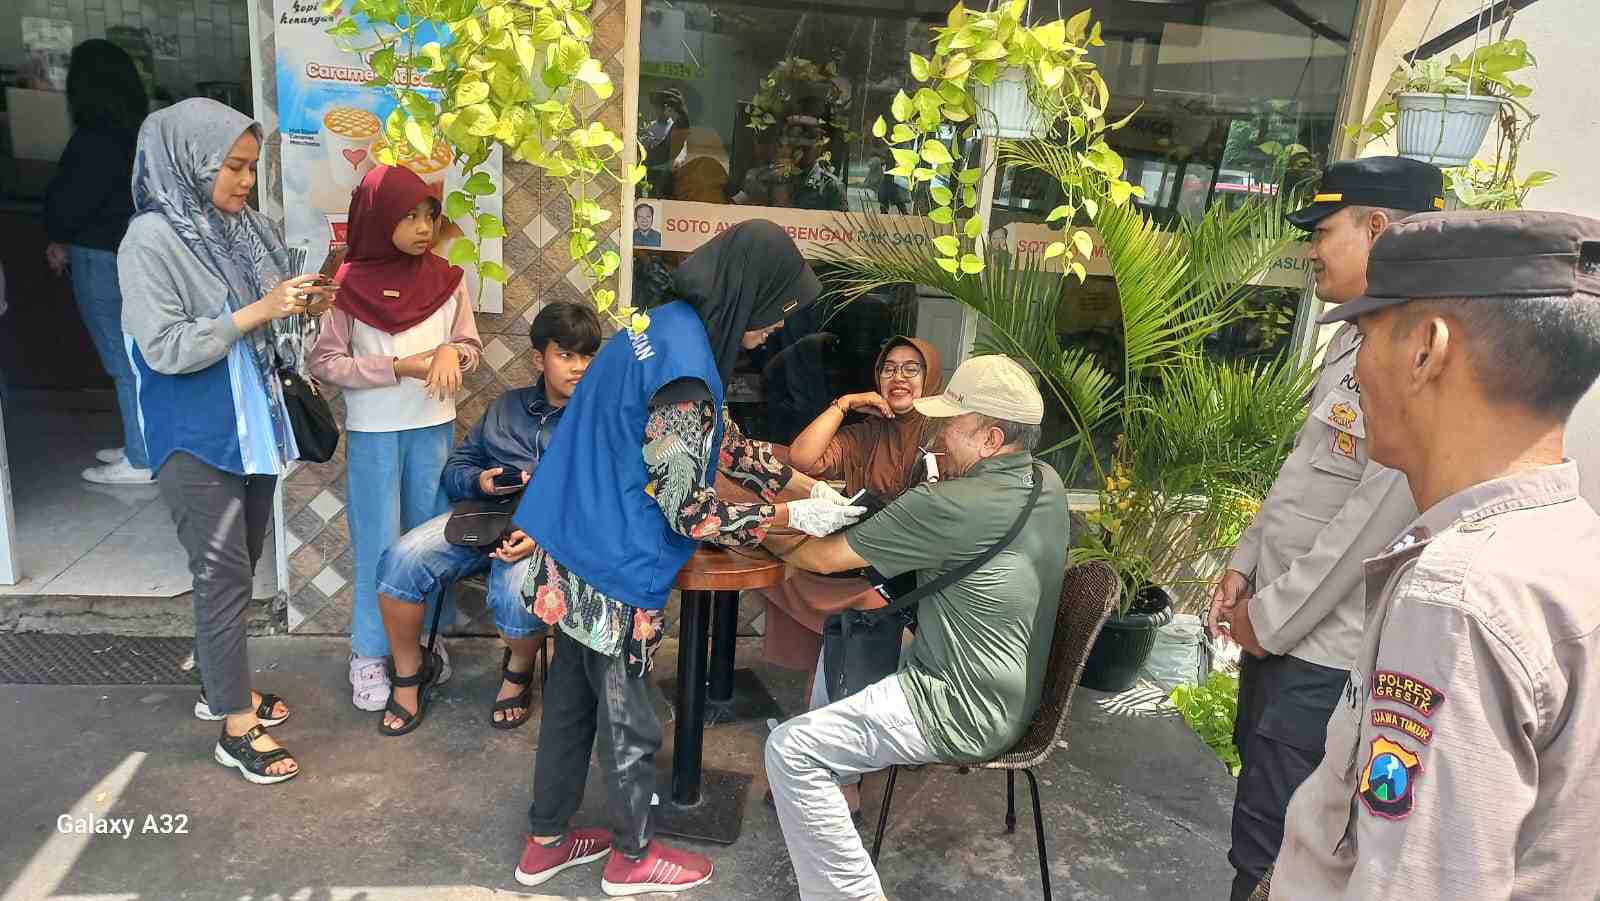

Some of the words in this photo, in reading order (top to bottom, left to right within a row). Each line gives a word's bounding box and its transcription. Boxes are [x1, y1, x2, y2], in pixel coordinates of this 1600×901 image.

[306, 63, 378, 82] Carame
[666, 219, 711, 234] SOTO
[784, 225, 853, 241] BENGAN
[1340, 373, 1361, 394] POL
[1378, 674, 1433, 702] POLRES
[1375, 711, 1399, 726] JAWA
[1400, 717, 1430, 740] TIMUR
